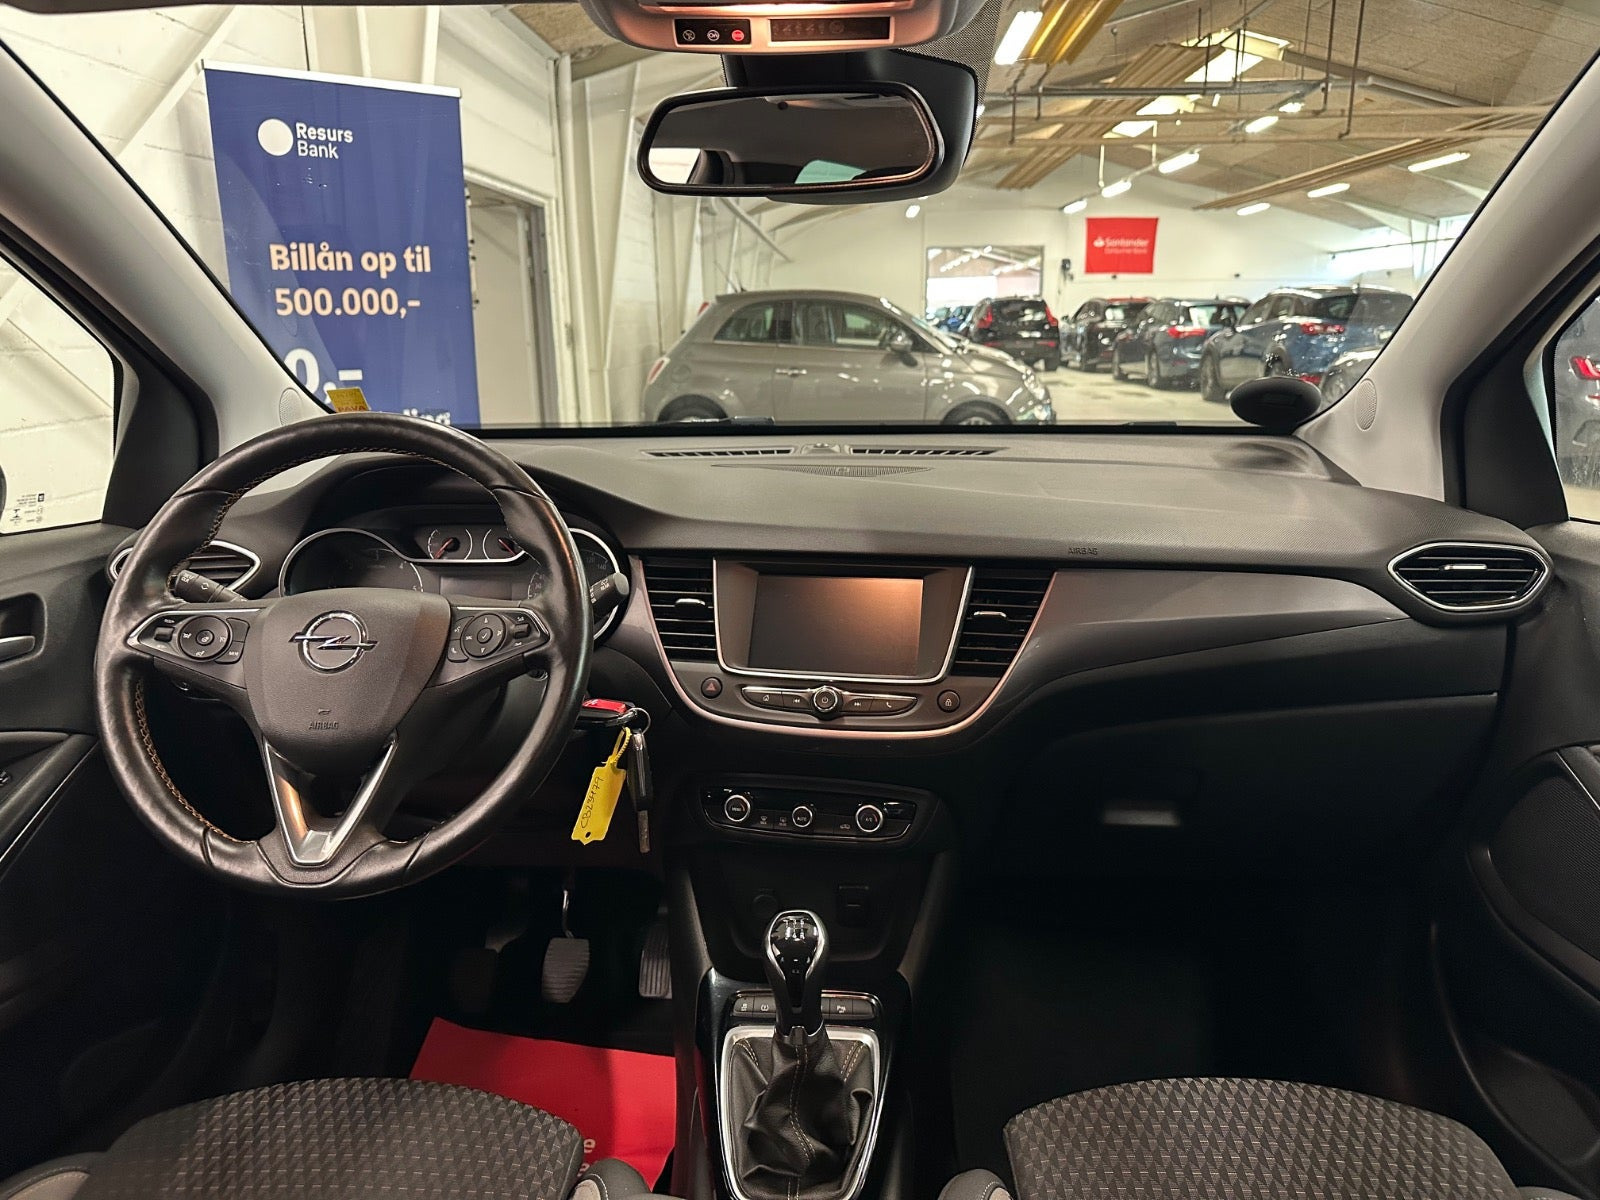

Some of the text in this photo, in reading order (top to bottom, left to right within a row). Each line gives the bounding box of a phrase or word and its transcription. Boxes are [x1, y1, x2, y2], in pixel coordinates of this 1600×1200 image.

[295, 121, 354, 144] Resurs
[297, 141, 339, 160] Bank
[269, 241, 431, 279] Billån op til
[275, 287, 421, 319] 500.000,-
[1068, 547, 1098, 556] AIRBAG
[309, 721, 339, 730] AIRBAG
